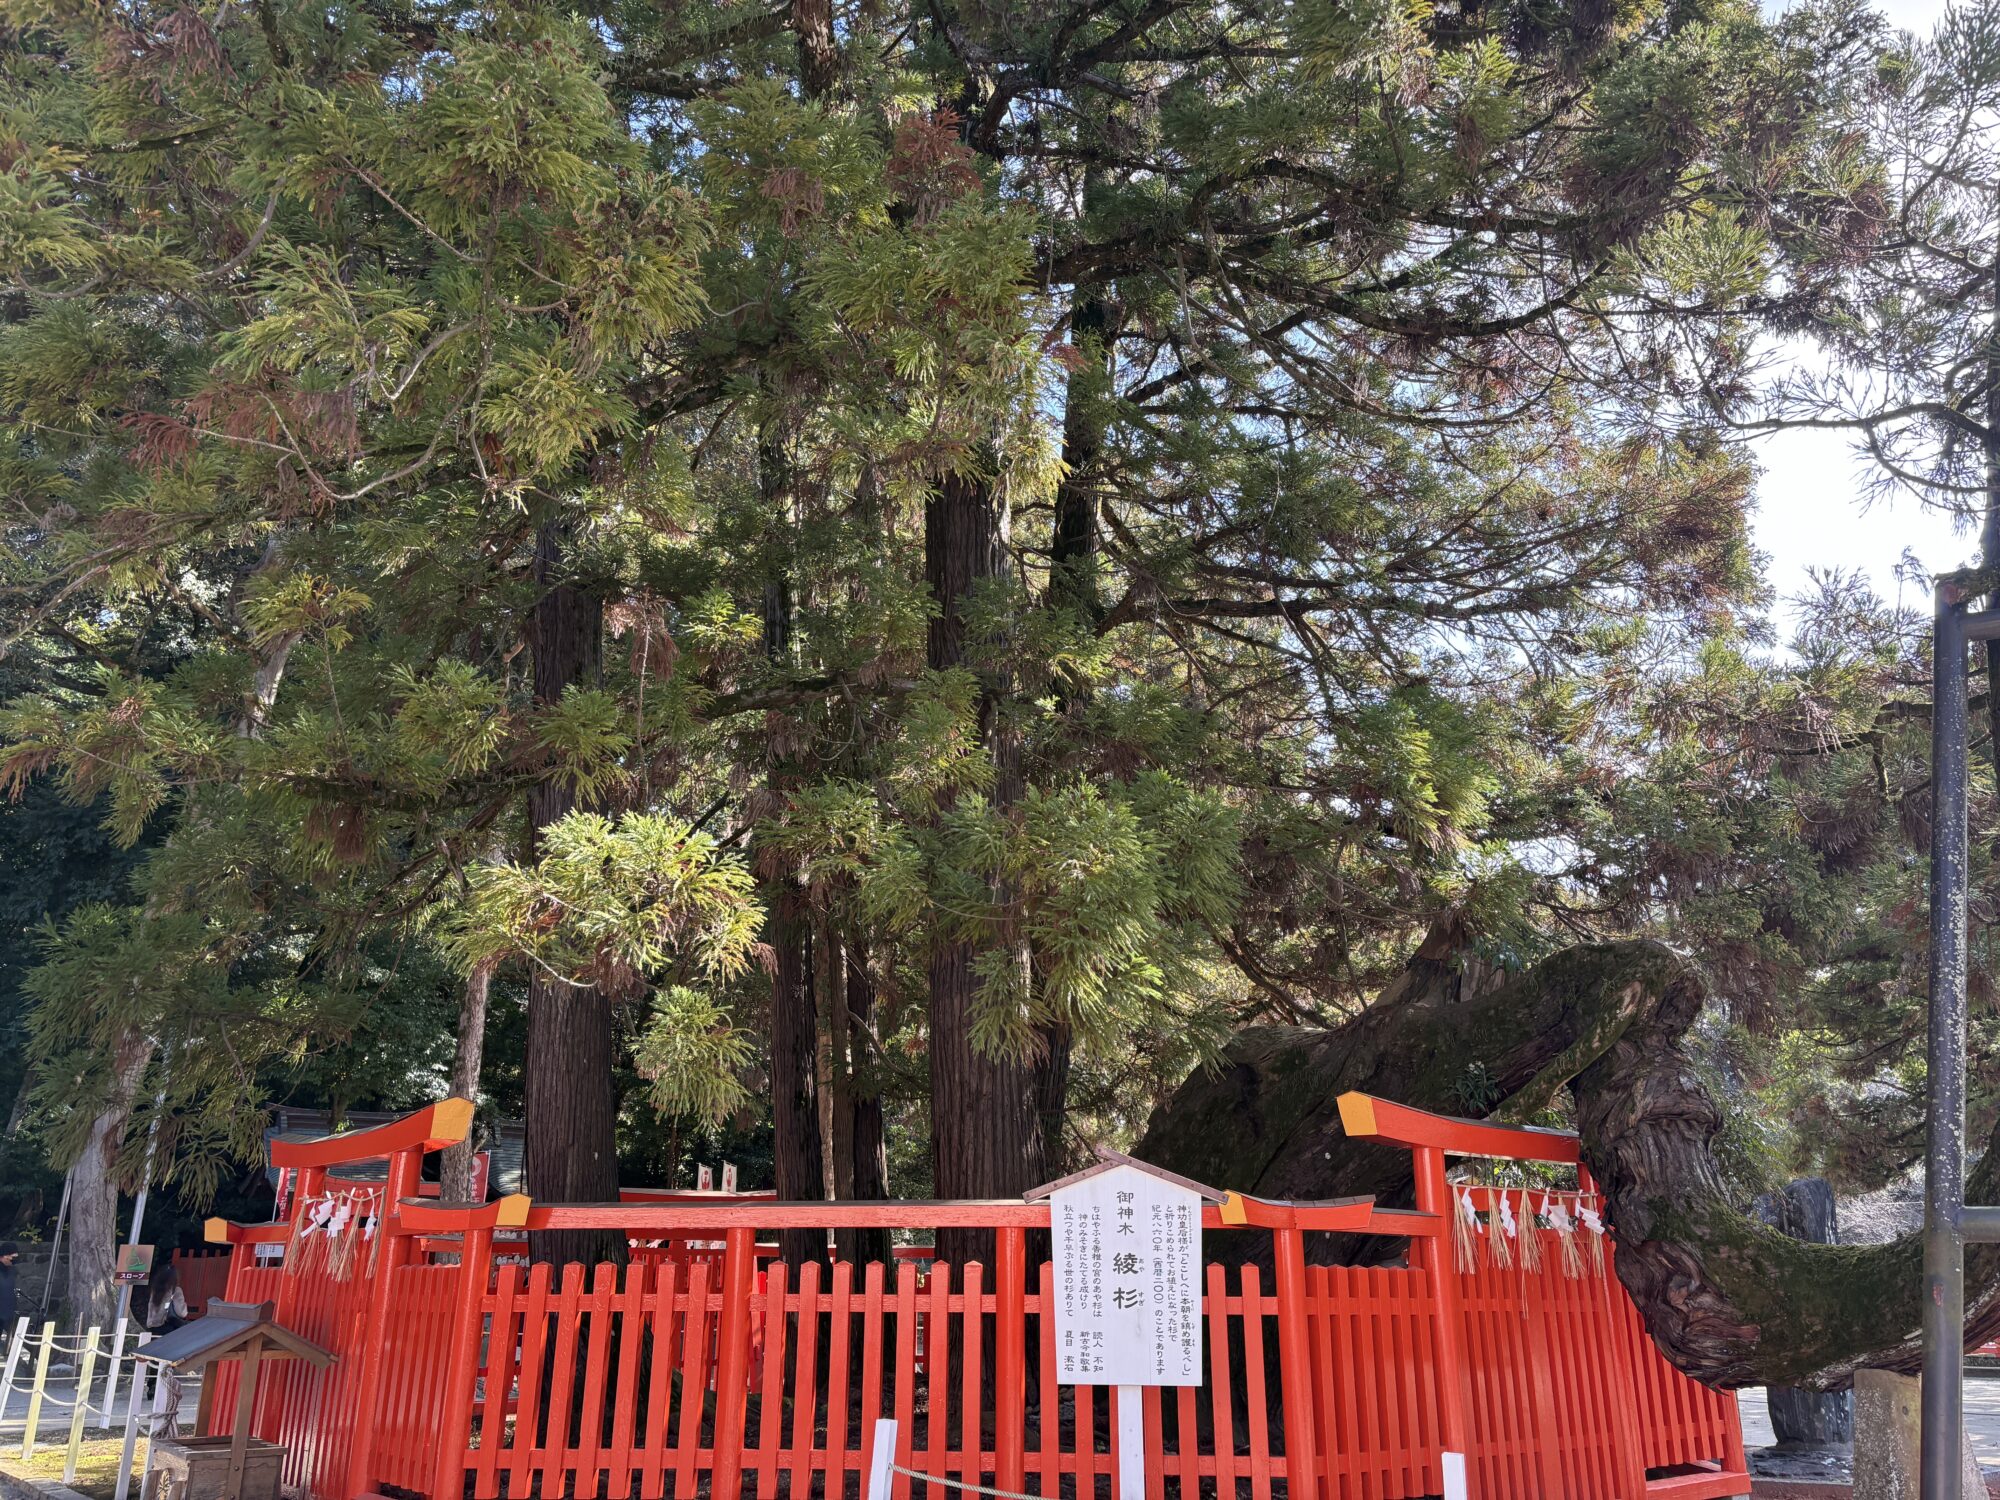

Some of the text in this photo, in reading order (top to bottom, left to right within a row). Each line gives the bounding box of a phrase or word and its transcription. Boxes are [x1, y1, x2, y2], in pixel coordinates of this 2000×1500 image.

[1064, 1204, 1074, 1317] 秋立つや千早ぶる世の杉ありて
[1092, 1205, 1103, 1317] ちはやふる香椎の宮のあや杉は
[1113, 1191, 1139, 1310] 御神木 綾杉
[1138, 1291, 1145, 1306] すぎ
[1165, 1205, 1178, 1343] と祈りこめられてお植えになった杉で
[1080, 1331, 1091, 1373] 新古今和歌集
[1093, 1357, 1104, 1373] 不知
